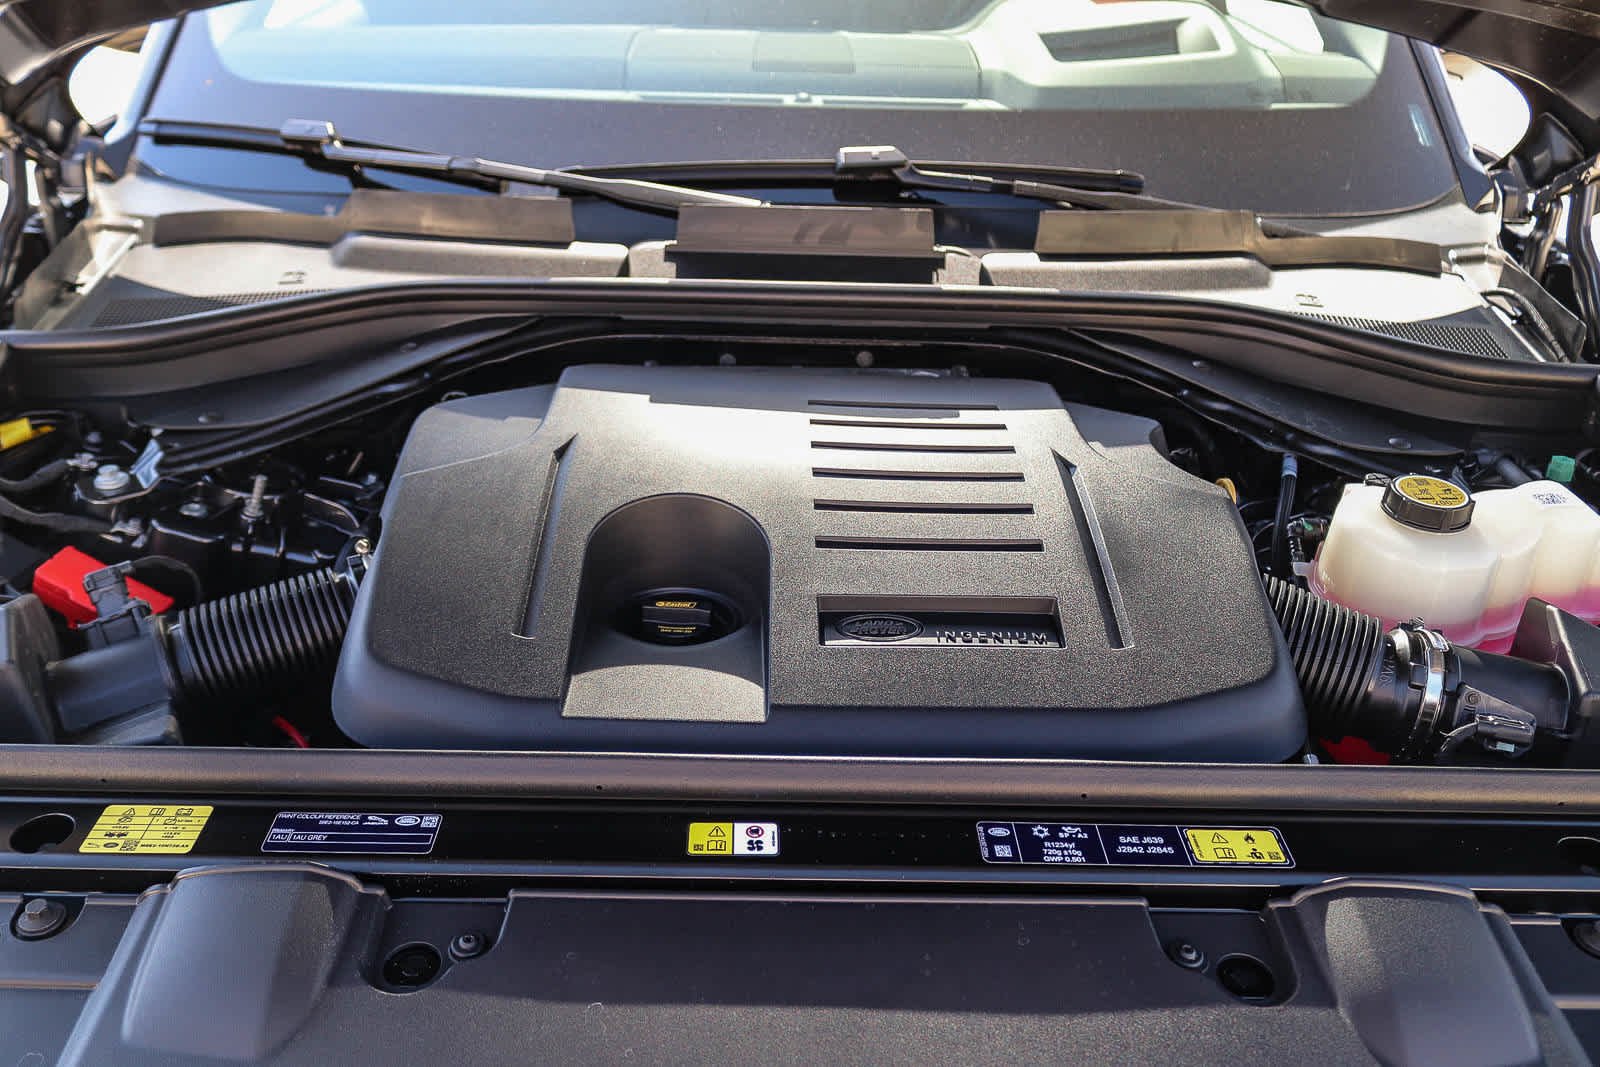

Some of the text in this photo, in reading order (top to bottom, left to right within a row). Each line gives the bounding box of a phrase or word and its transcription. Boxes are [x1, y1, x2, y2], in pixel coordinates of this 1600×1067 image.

[855, 619, 894, 627] LAND
[857, 626, 908, 635] ROVER
[936, 631, 1049, 645] INGENIUM
[1118, 836, 1164, 844] SAE J639
[1043, 841, 1075, 849] R1234yf
[1042, 848, 1062, 856] 720g
[1116, 846, 1175, 854] J2842 J2845
